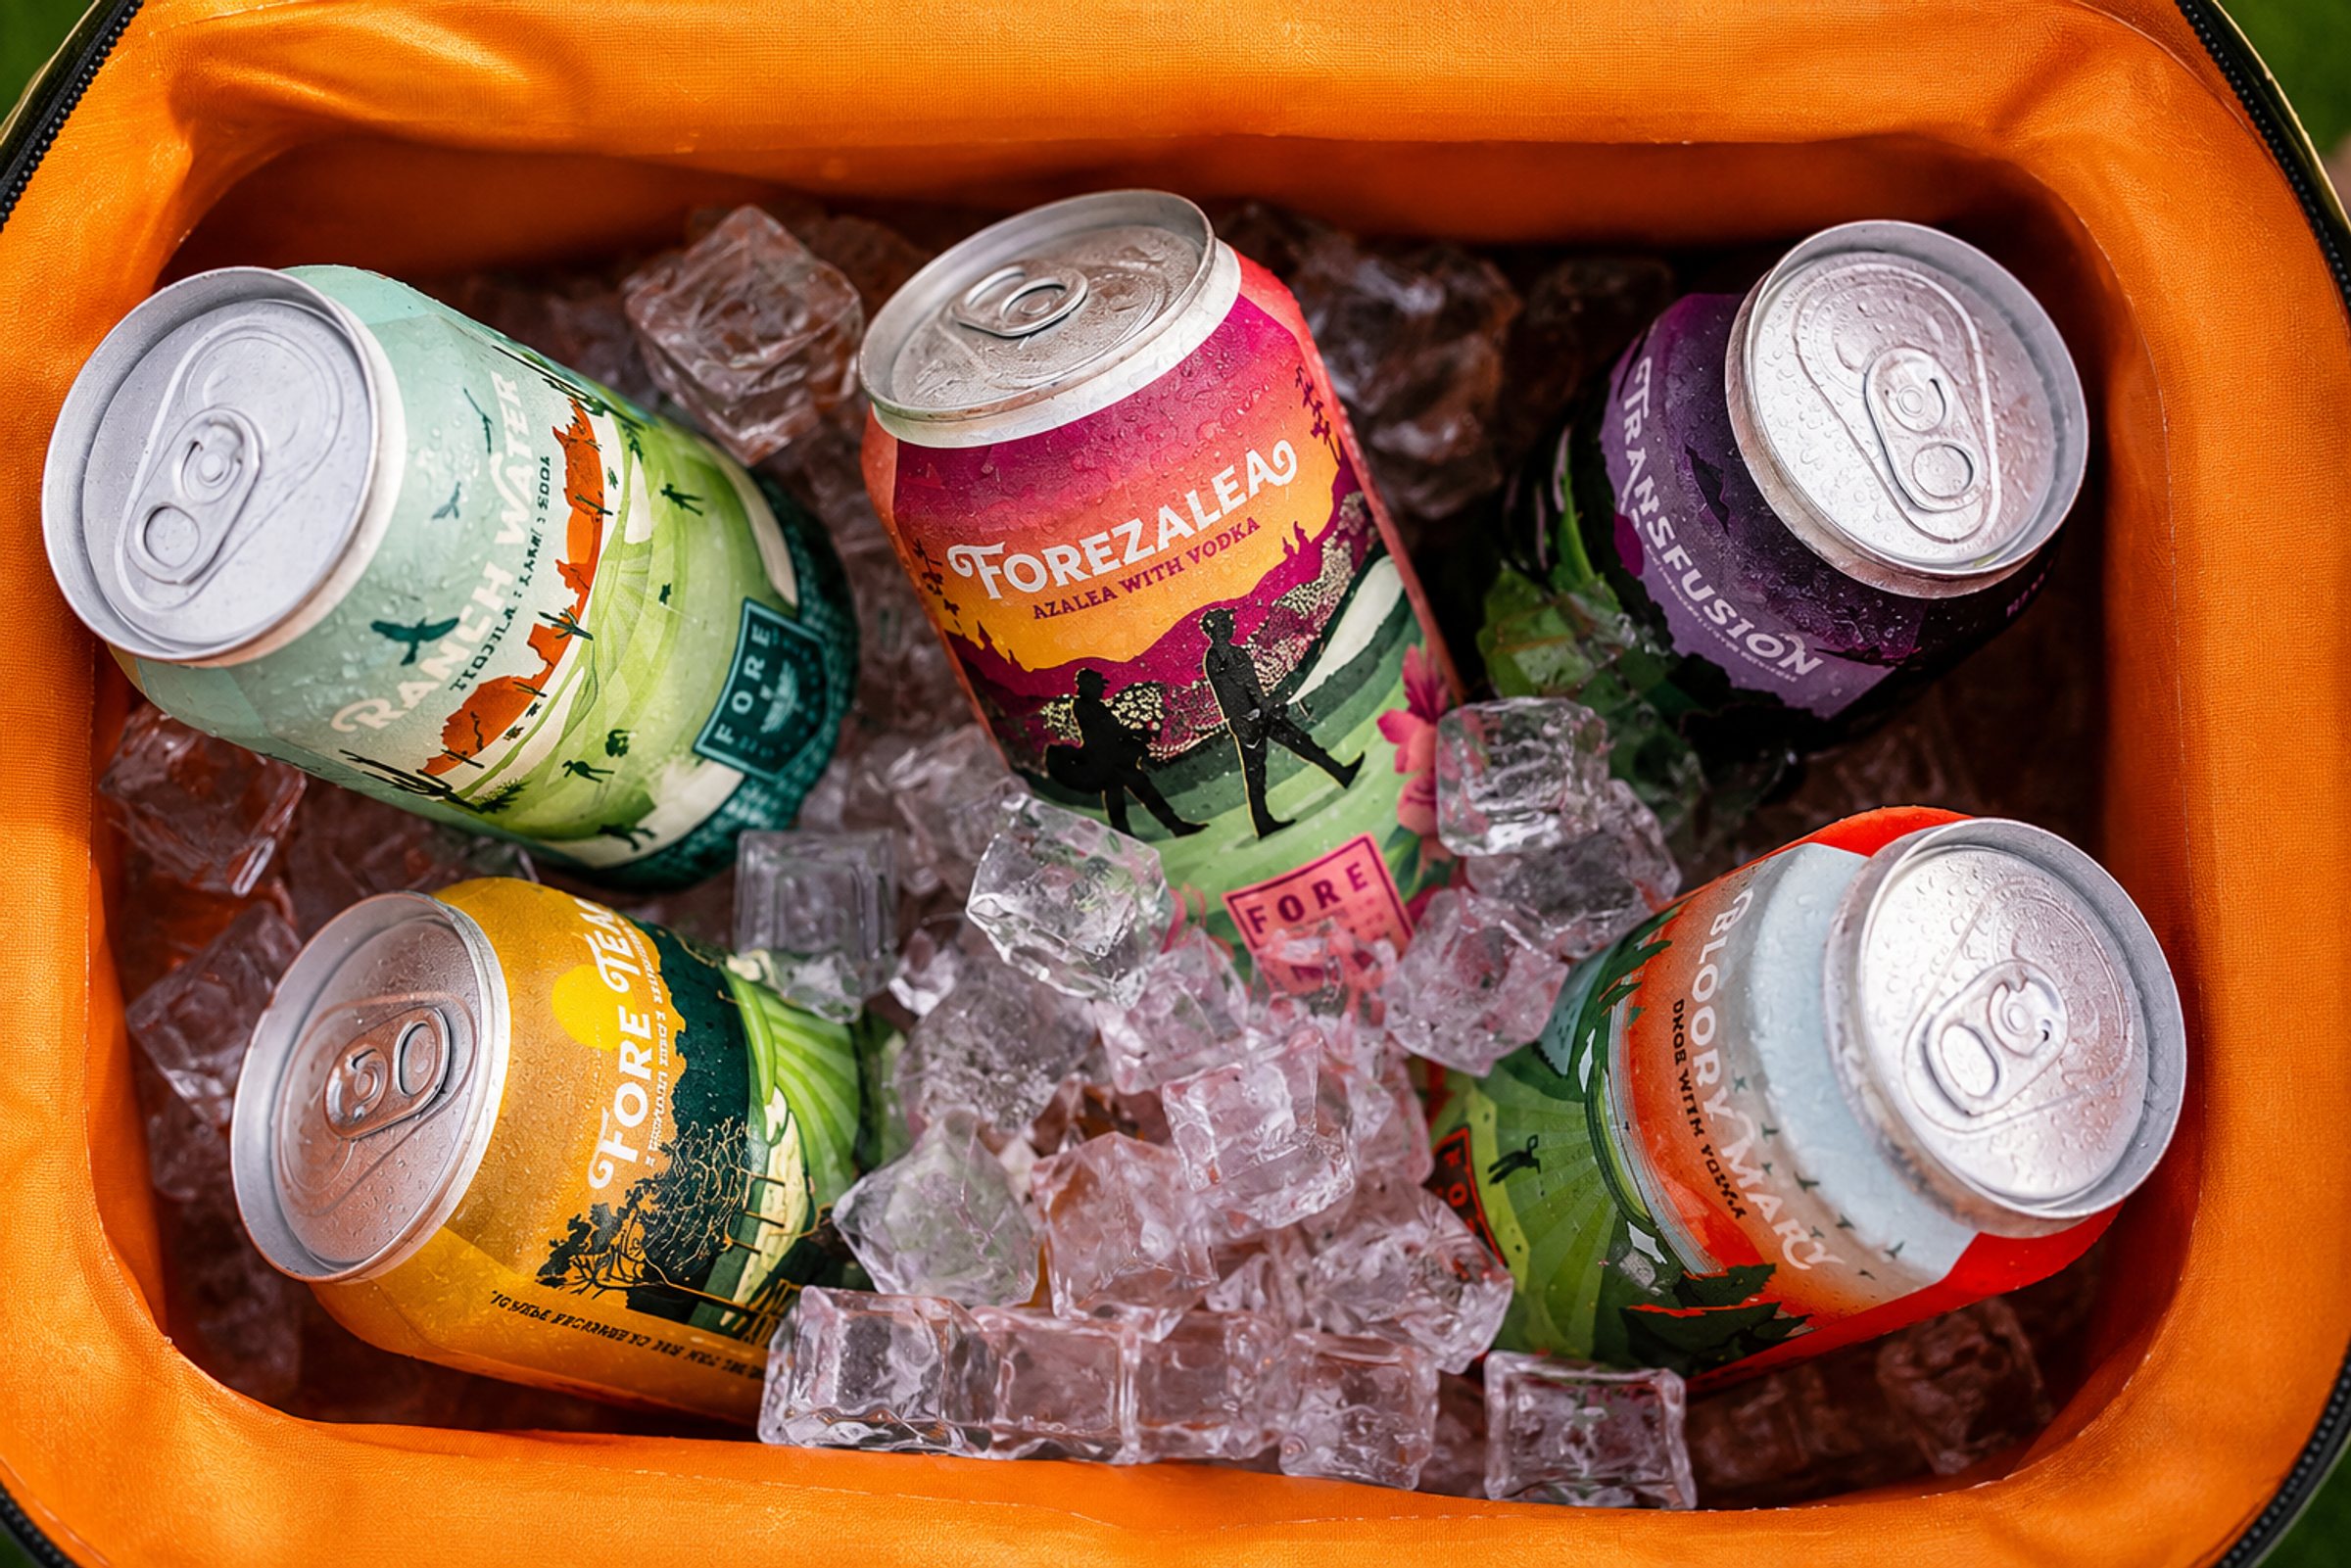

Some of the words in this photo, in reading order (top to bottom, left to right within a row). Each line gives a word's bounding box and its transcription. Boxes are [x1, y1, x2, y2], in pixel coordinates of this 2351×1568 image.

[330, 560, 514, 733] RANCH
[490, 370, 535, 546] WATER
[947, 440, 1297, 599] FOREZALEA
[1032, 586, 1119, 620] AZALEA
[1118, 556, 1185, 594] WITH
[1185, 516, 1261, 565] VODKA
[1619, 356, 1824, 676] TRANSFUSION
[714, 624, 771, 745] FORE
[1245, 862, 1368, 934] FORE
[588, 1004, 652, 1190] FORE
[1720, 1110, 1846, 1270] MARY
